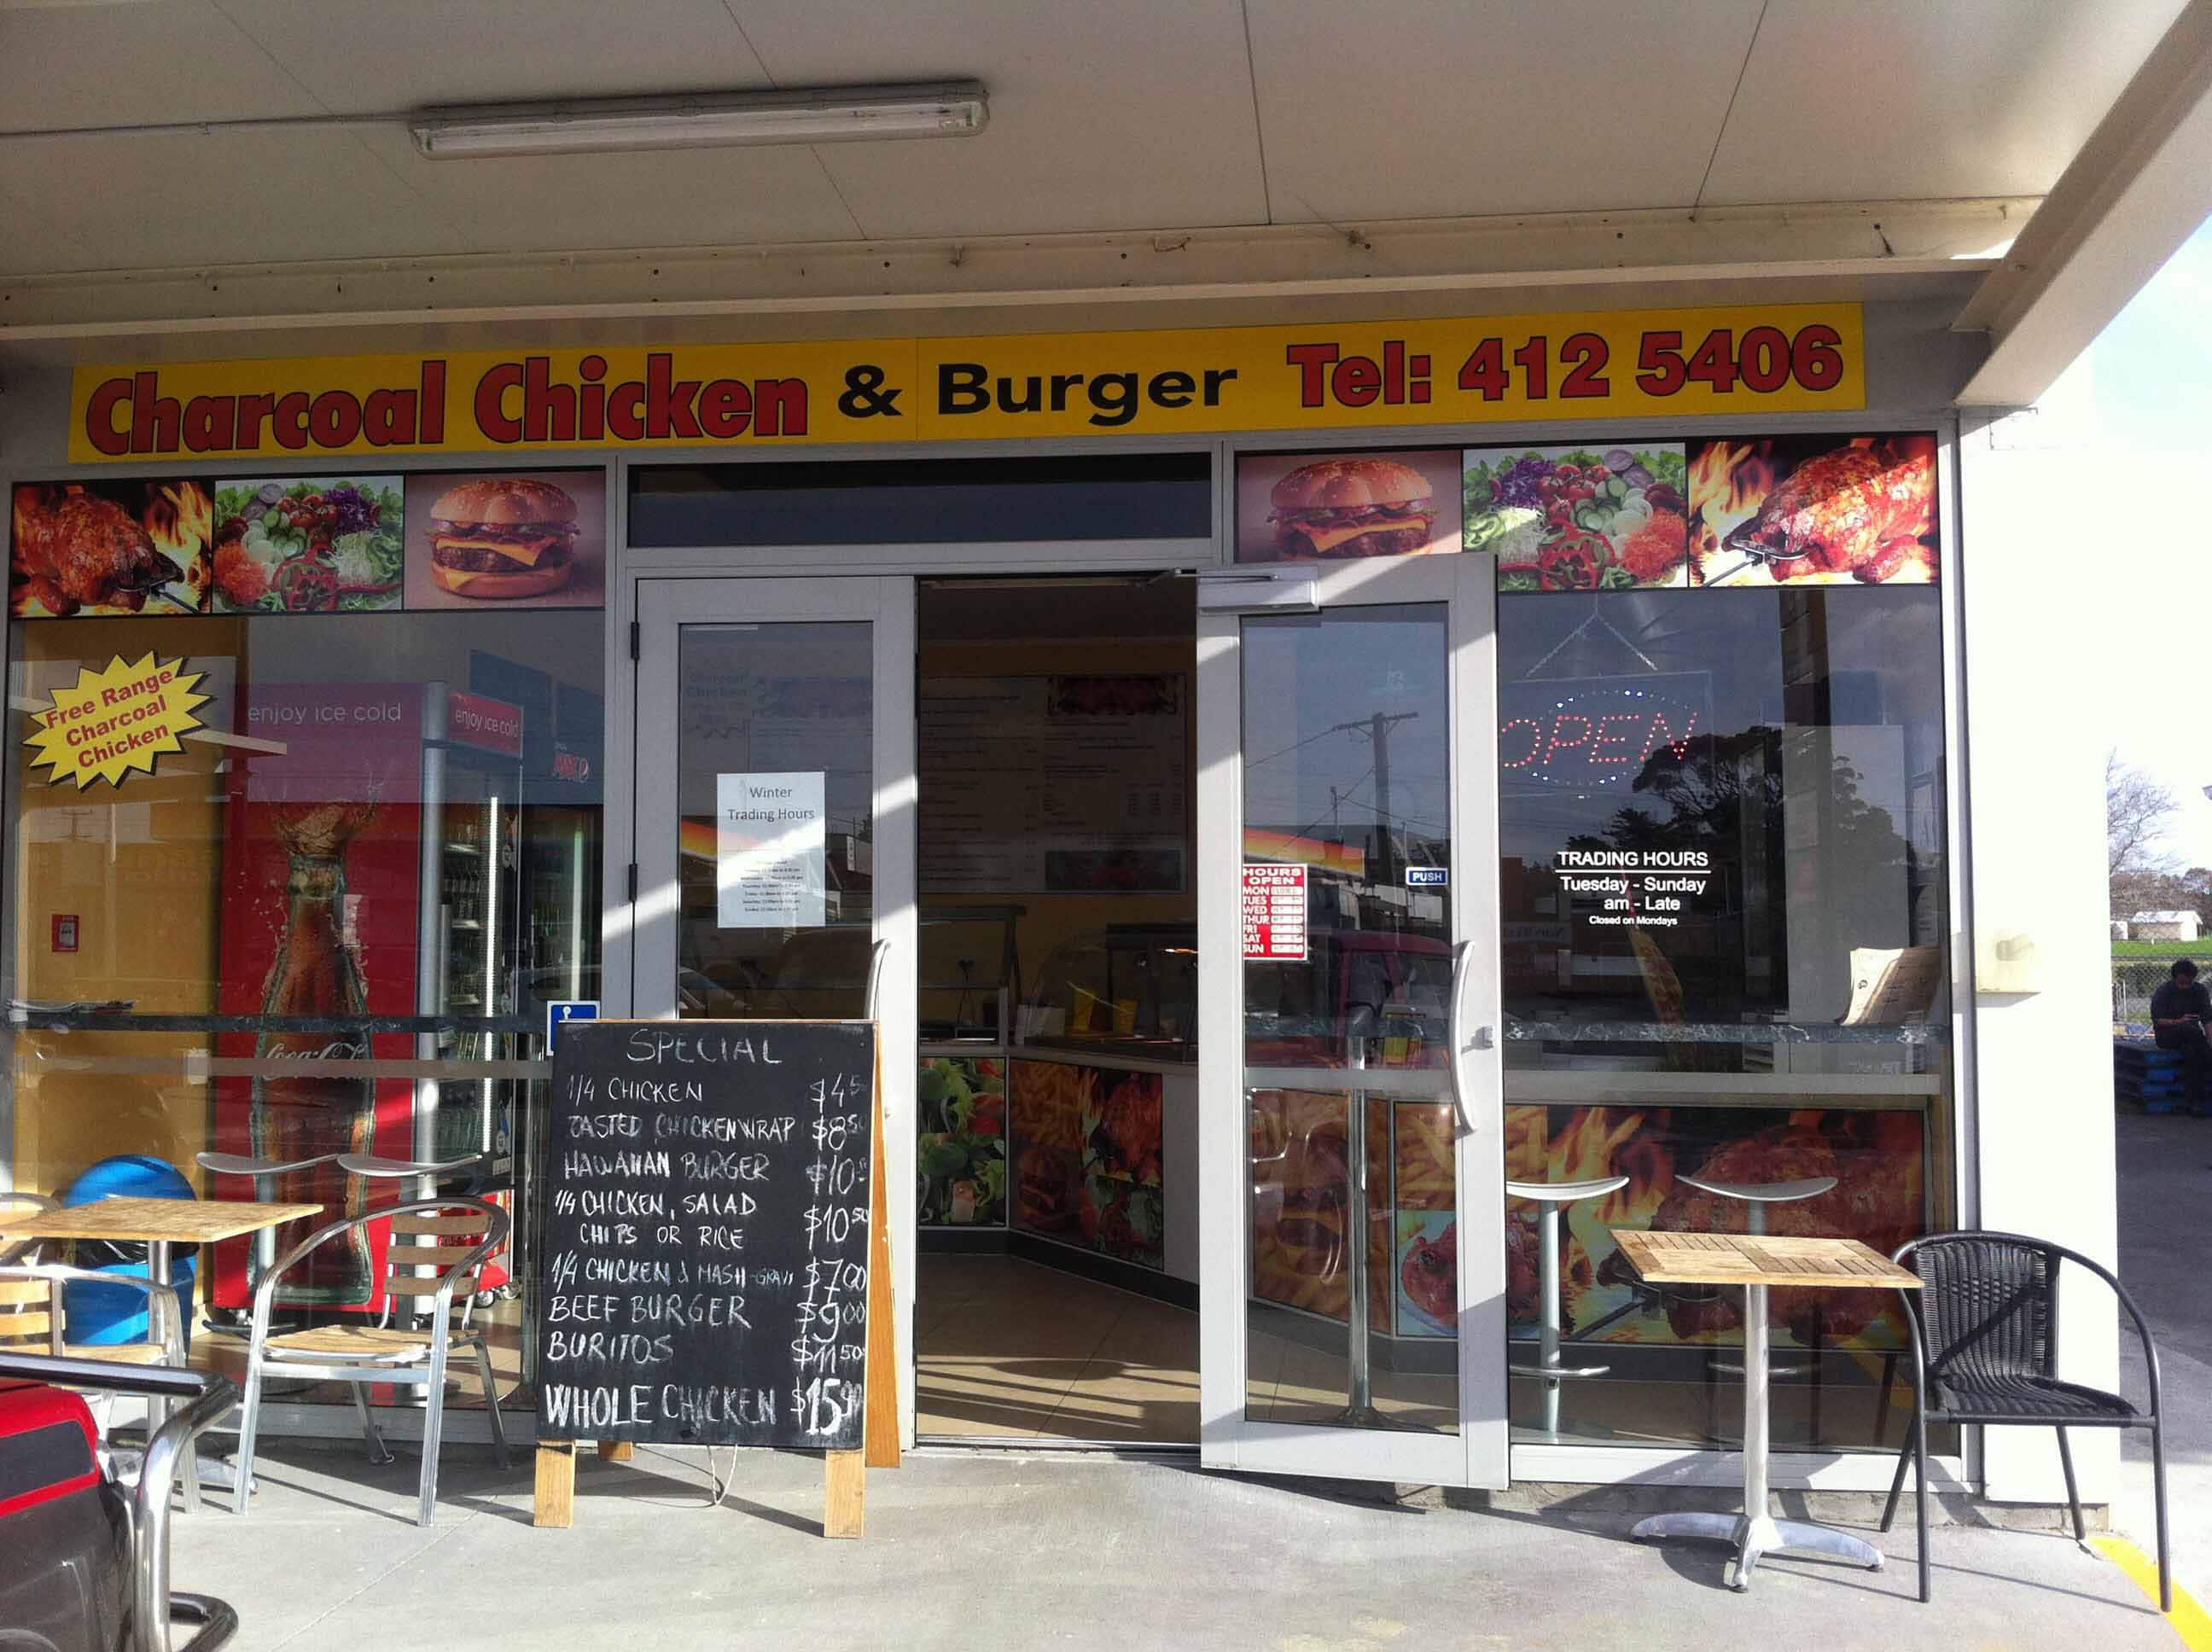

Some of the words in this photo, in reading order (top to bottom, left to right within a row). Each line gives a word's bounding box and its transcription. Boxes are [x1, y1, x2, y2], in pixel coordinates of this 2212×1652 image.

[85, 359, 446, 456] Charcoal
[474, 352, 808, 444] Chicken
[837, 364, 903, 418] &
[938, 363, 1237, 426] Burger
[1286, 340, 1431, 408] Tel:
[1458, 332, 1610, 401] 412
[1635, 324, 1843, 397] 5406
[45, 700, 96, 730] Free
[101, 670, 173, 707] Range
[66, 694, 167, 747] Charcoal
[248, 703, 306, 726] enjoy
[315, 703, 346, 723] ice
[353, 702, 402, 723] cold
[455, 709, 483, 731] enjoy
[78, 724, 169, 768] Chicken
[1501, 712, 1698, 769] OPEN
[749, 785, 793, 799] Winter
[727, 808, 774, 823] Trading
[777, 807, 815, 820] Hours
[1557, 851, 1639, 867] TRADING
[1644, 851, 1708, 867] HOURS
[1243, 868, 1301, 876] HOURS
[1249, 876, 1295, 885] OPEN
[1412, 871, 1442, 881] PUSH
[1243, 886, 1270, 895] MON
[1559, 875, 1630, 894] Tuesday
[1644, 875, 1706, 895] Sunday
[1243, 896, 1267, 905] TUES
[1243, 905, 1267, 914] WED
[1604, 899, 1630, 910] am
[1644, 897, 1681, 910] Late
[1589, 916, 1621, 925] Closed
[1636, 916, 1678, 927] Mondays
[626, 1028, 783, 1065] SPECIAL
[567, 1074, 596, 1107] 1/4
[608, 1076, 704, 1103] CHICKEN
[680, 1149, 770, 1182] BURGER
[683, 1191, 757, 1216] SALAD
[580, 1222, 638, 1245] CHIPS
[657, 1225, 683, 1246] OR
[698, 1225, 745, 1250] RICE
[585, 1257, 671, 1286] CHICKEN
[698, 1263, 746, 1288] MASH
[549, 1294, 621, 1323] BEEF
[631, 1293, 752, 1330] BURGER
[547, 1330, 674, 1364] BURITOS
[545, 1383, 655, 1428] WHOLE
[661, 1383, 777, 1427] CHICKEN
